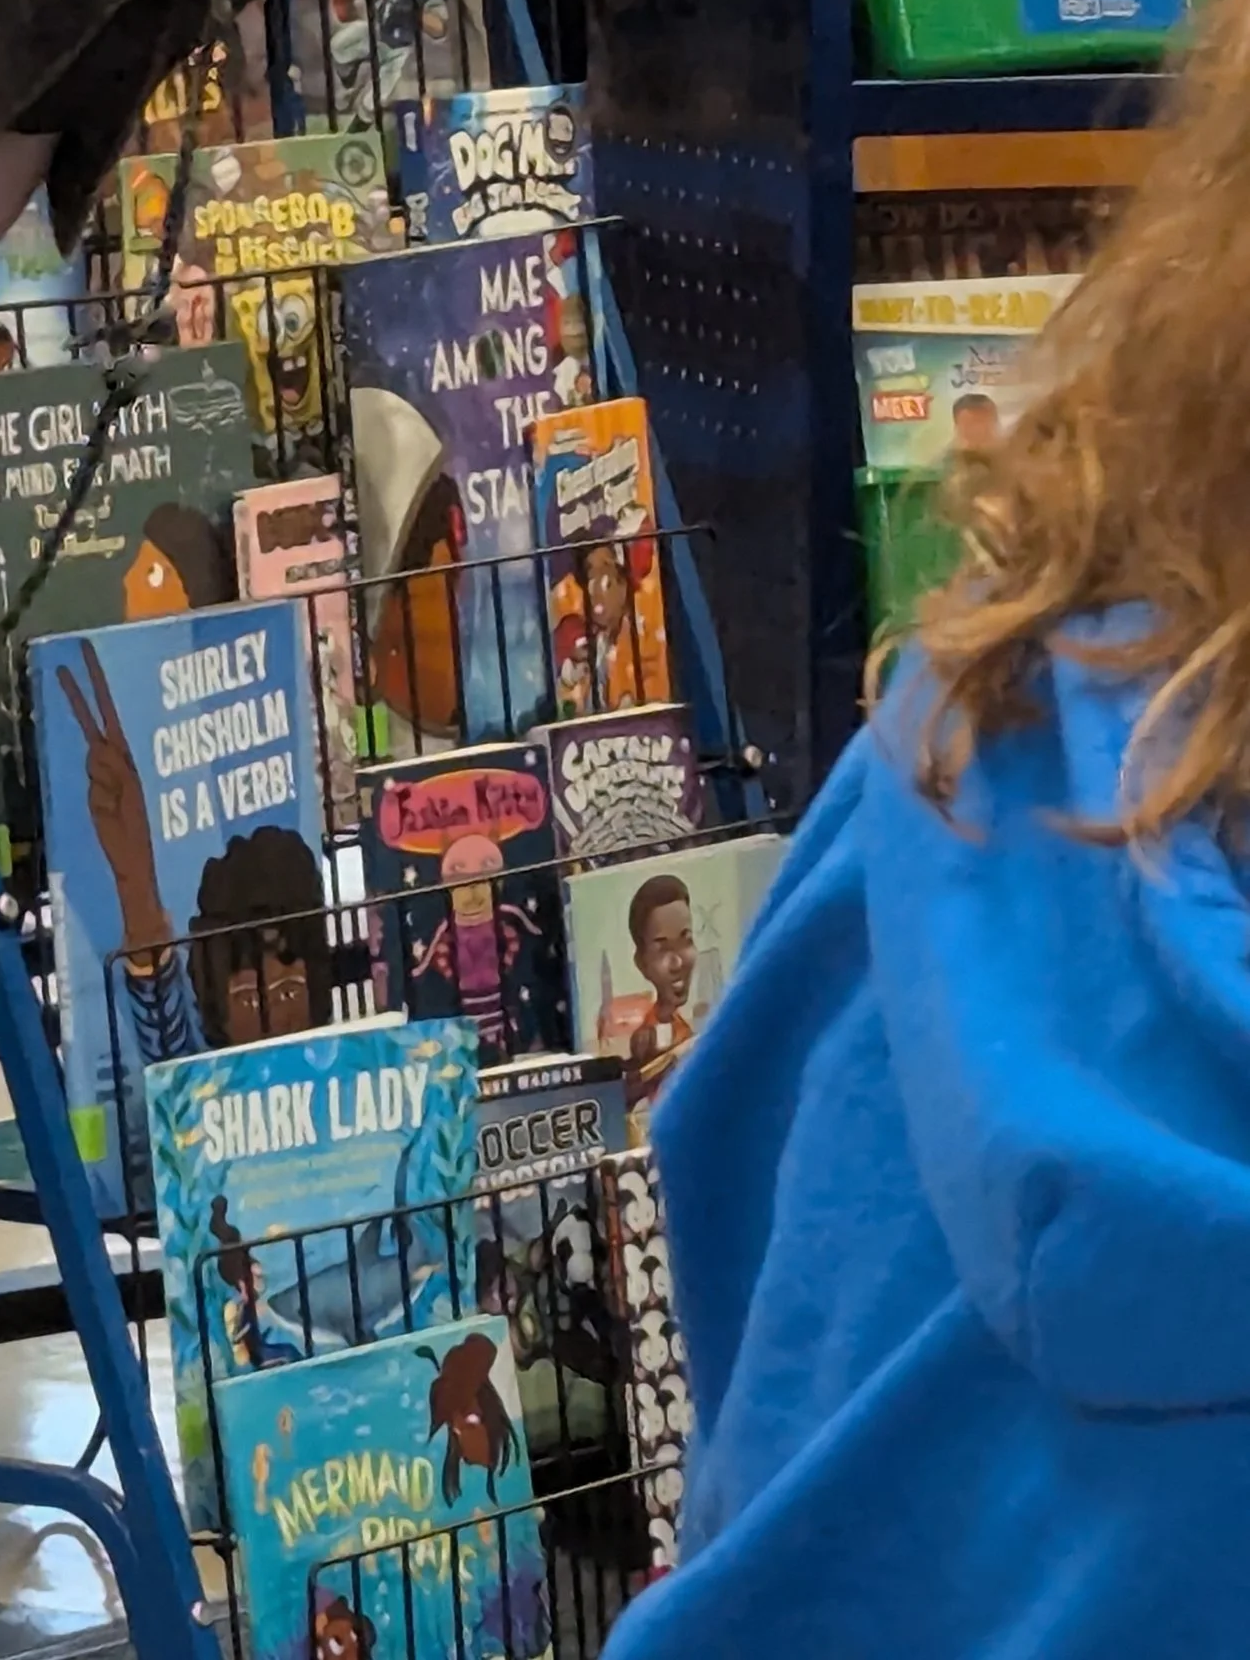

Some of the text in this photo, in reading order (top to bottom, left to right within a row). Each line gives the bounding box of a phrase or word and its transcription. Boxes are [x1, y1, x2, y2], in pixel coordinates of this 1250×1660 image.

[450, 130, 514, 191] DOG
[195, 193, 356, 238] SPONGEBOB
[480, 255, 544, 314] MAE
[28, 403, 89, 450] GIRL
[93, 391, 167, 440] ITH
[5, 462, 57, 499] MIND
[110, 445, 171, 483] MATH
[466, 468, 531, 526] STA
[160, 630, 267, 710] SHIRLEY
[154, 689, 290, 778] CHISHOLM
[160, 752, 297, 840] IS A VERB!
[201, 1084, 317, 1164] SHARK
[329, 1063, 429, 1142] LADY
[480, 1100, 605, 1169] OCCER
[272, 1451, 434, 1547] MERMAID
